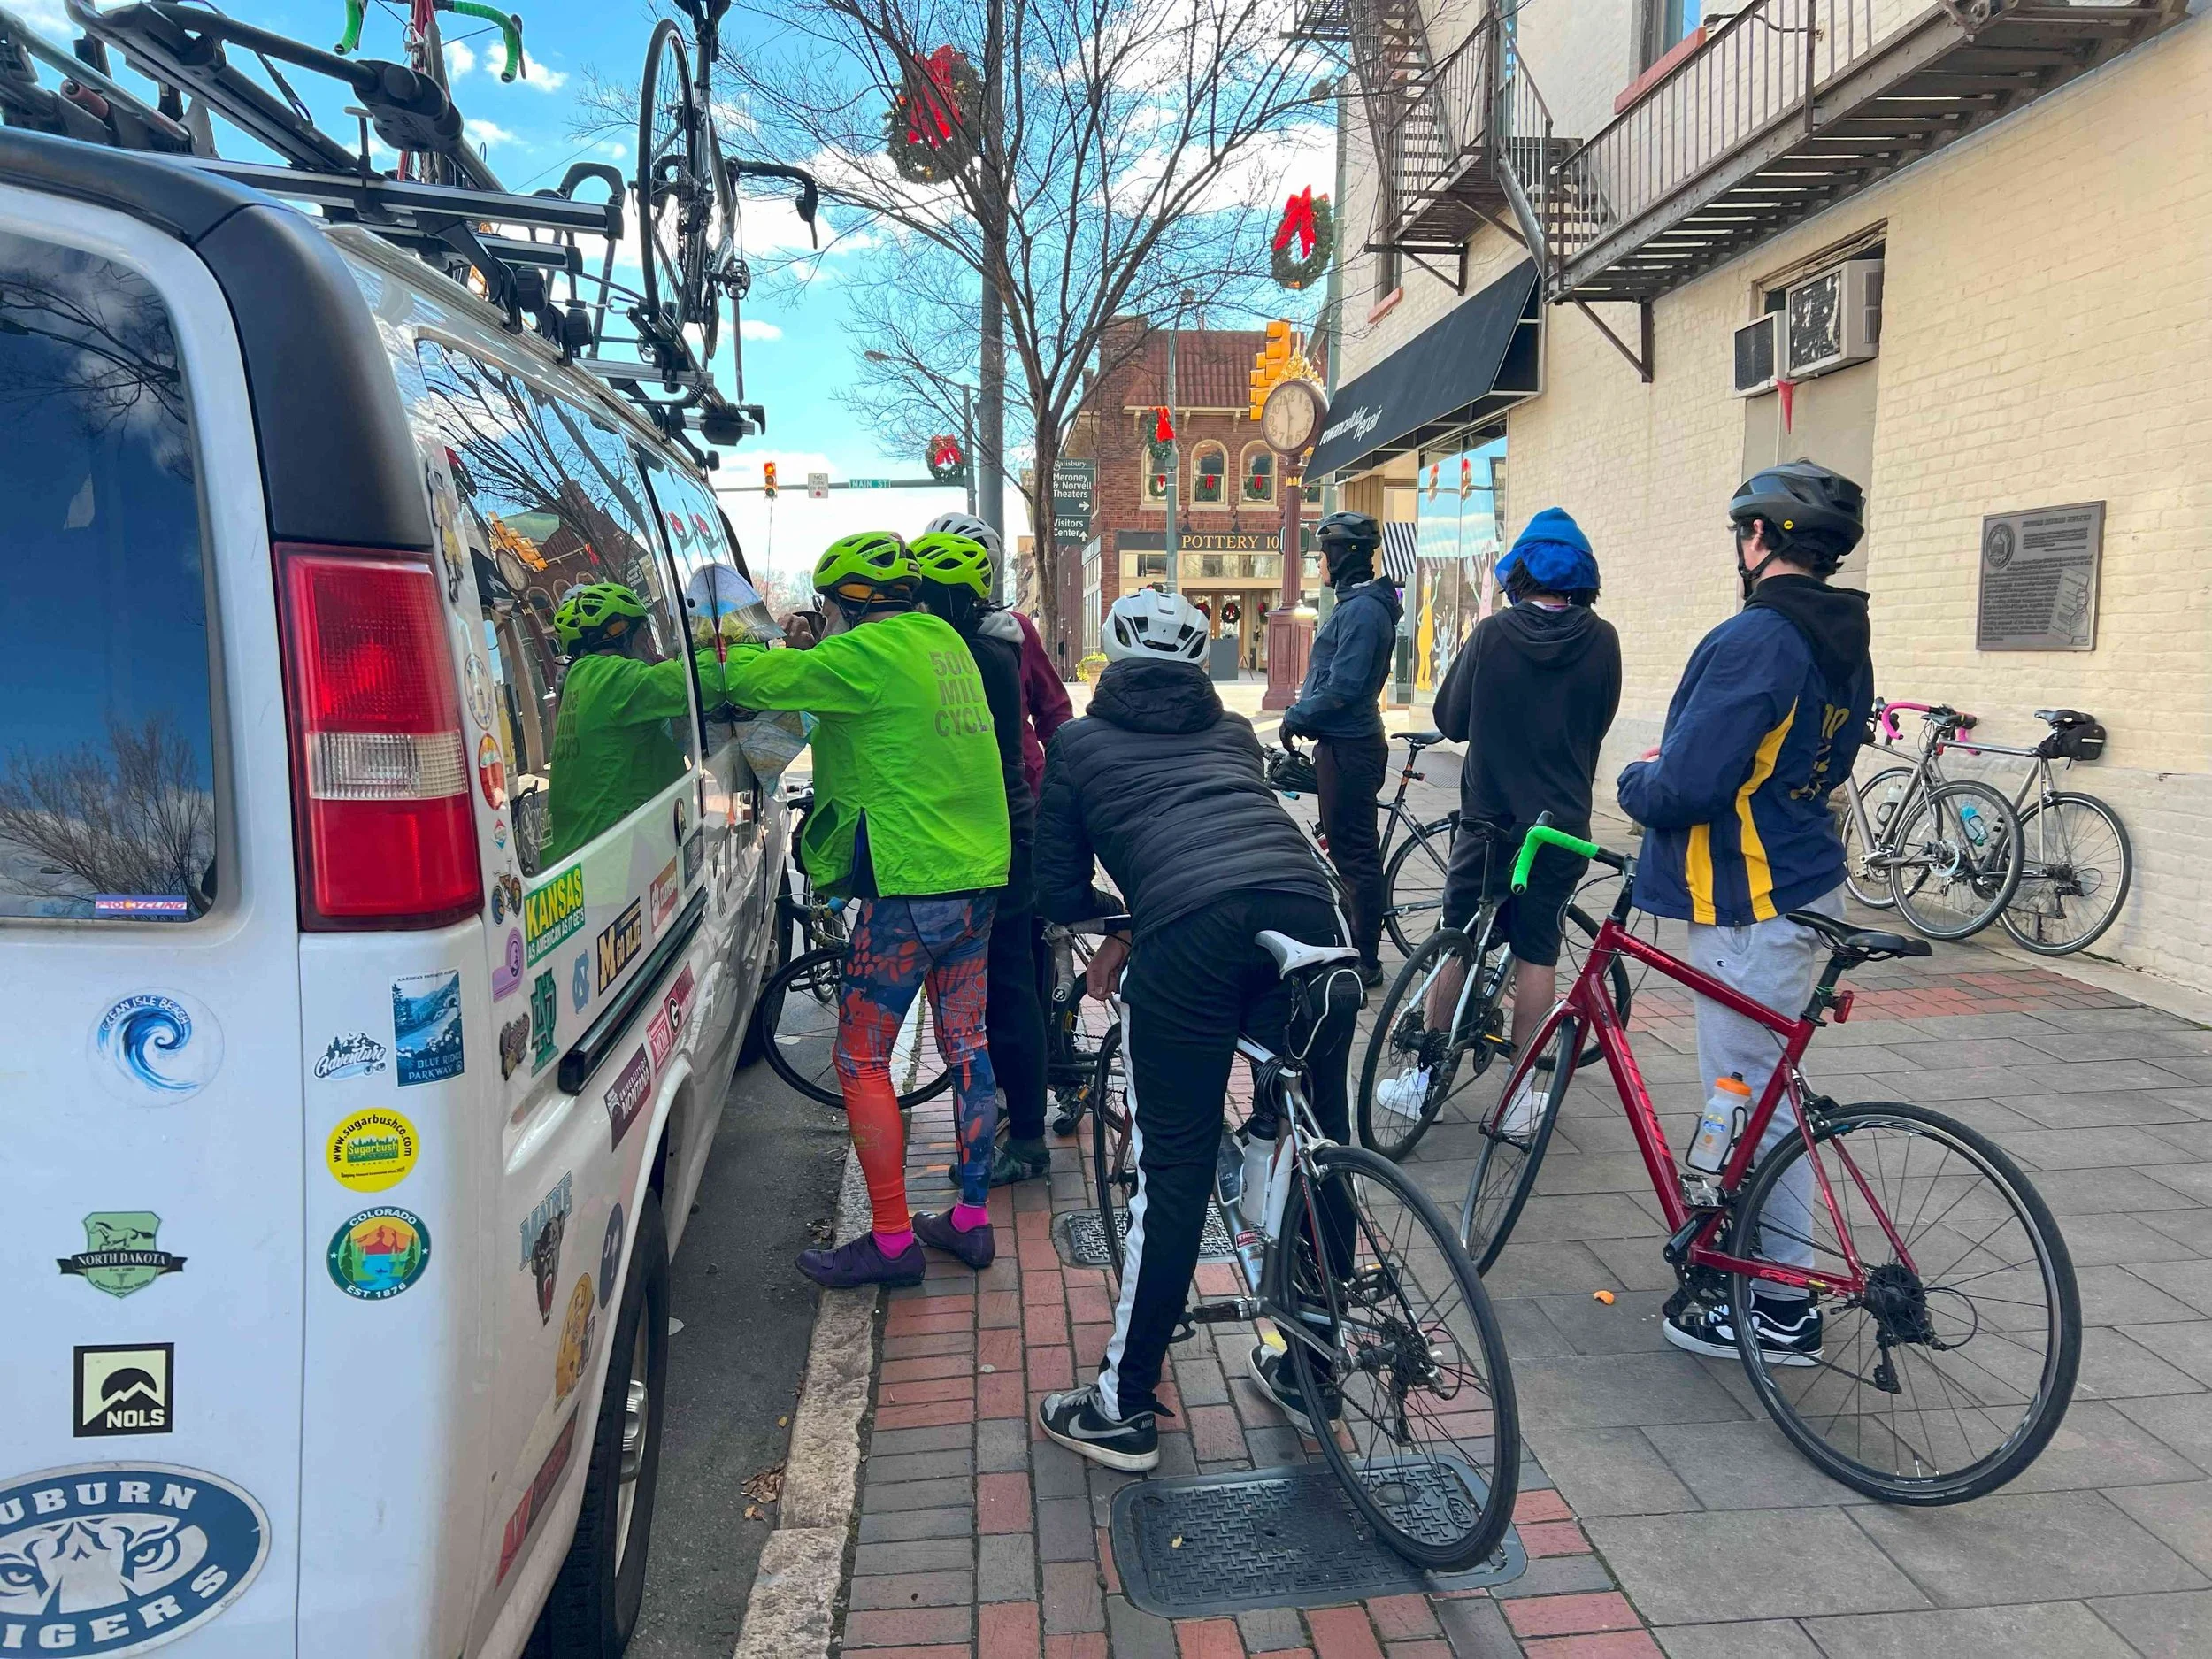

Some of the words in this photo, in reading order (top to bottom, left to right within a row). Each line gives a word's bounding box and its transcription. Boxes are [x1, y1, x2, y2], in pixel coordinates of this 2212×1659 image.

[1053, 459, 1087, 471] Salisbury
[1053, 472, 1088, 483] Meroney
[1062, 481, 1092, 490] Norvell
[1053, 489, 1088, 498] Theaters
[1054, 518, 1084, 527] Visitors
[1054, 528, 1079, 537] Center
[1181, 534, 1259, 549] POTTERY
[526, 868, 583, 942] KANSAS
[528, 943, 536, 964] AS
[536, 924, 562, 956] AMERICAN
[572, 906, 585, 927] GETS
[599, 924, 617, 991] M
[101, 1000, 131, 1031] OCEAN
[132, 995, 157, 1007] ISLE
[158, 997, 191, 1025] BEACH
[315, 1044, 386, 1078] Adventure
[417, 1056, 440, 1069] BLUE
[442, 1051, 463, 1064] RIDGE
[408, 1064, 456, 1080] PARKWAY
[619, 1065, 641, 1101] UNIVERSITY
[621, 1067, 651, 1120] MONTANA
[334, 1114, 412, 1163] www.sugarbushco.com
[348, 1140, 398, 1156] Sugarbush
[349, 1208, 418, 1227] COLORADO
[519, 1171, 572, 1272] MAINE
[78, 1252, 118, 1266] NORTH
[119, 1252, 166, 1265] DAKOTA
[346, 1285, 371, 1298] EST
[375, 1282, 407, 1298] 1876
[106, 1409, 165, 1429] NOLS
[1140, 1418, 1155, 1430] NIKE
